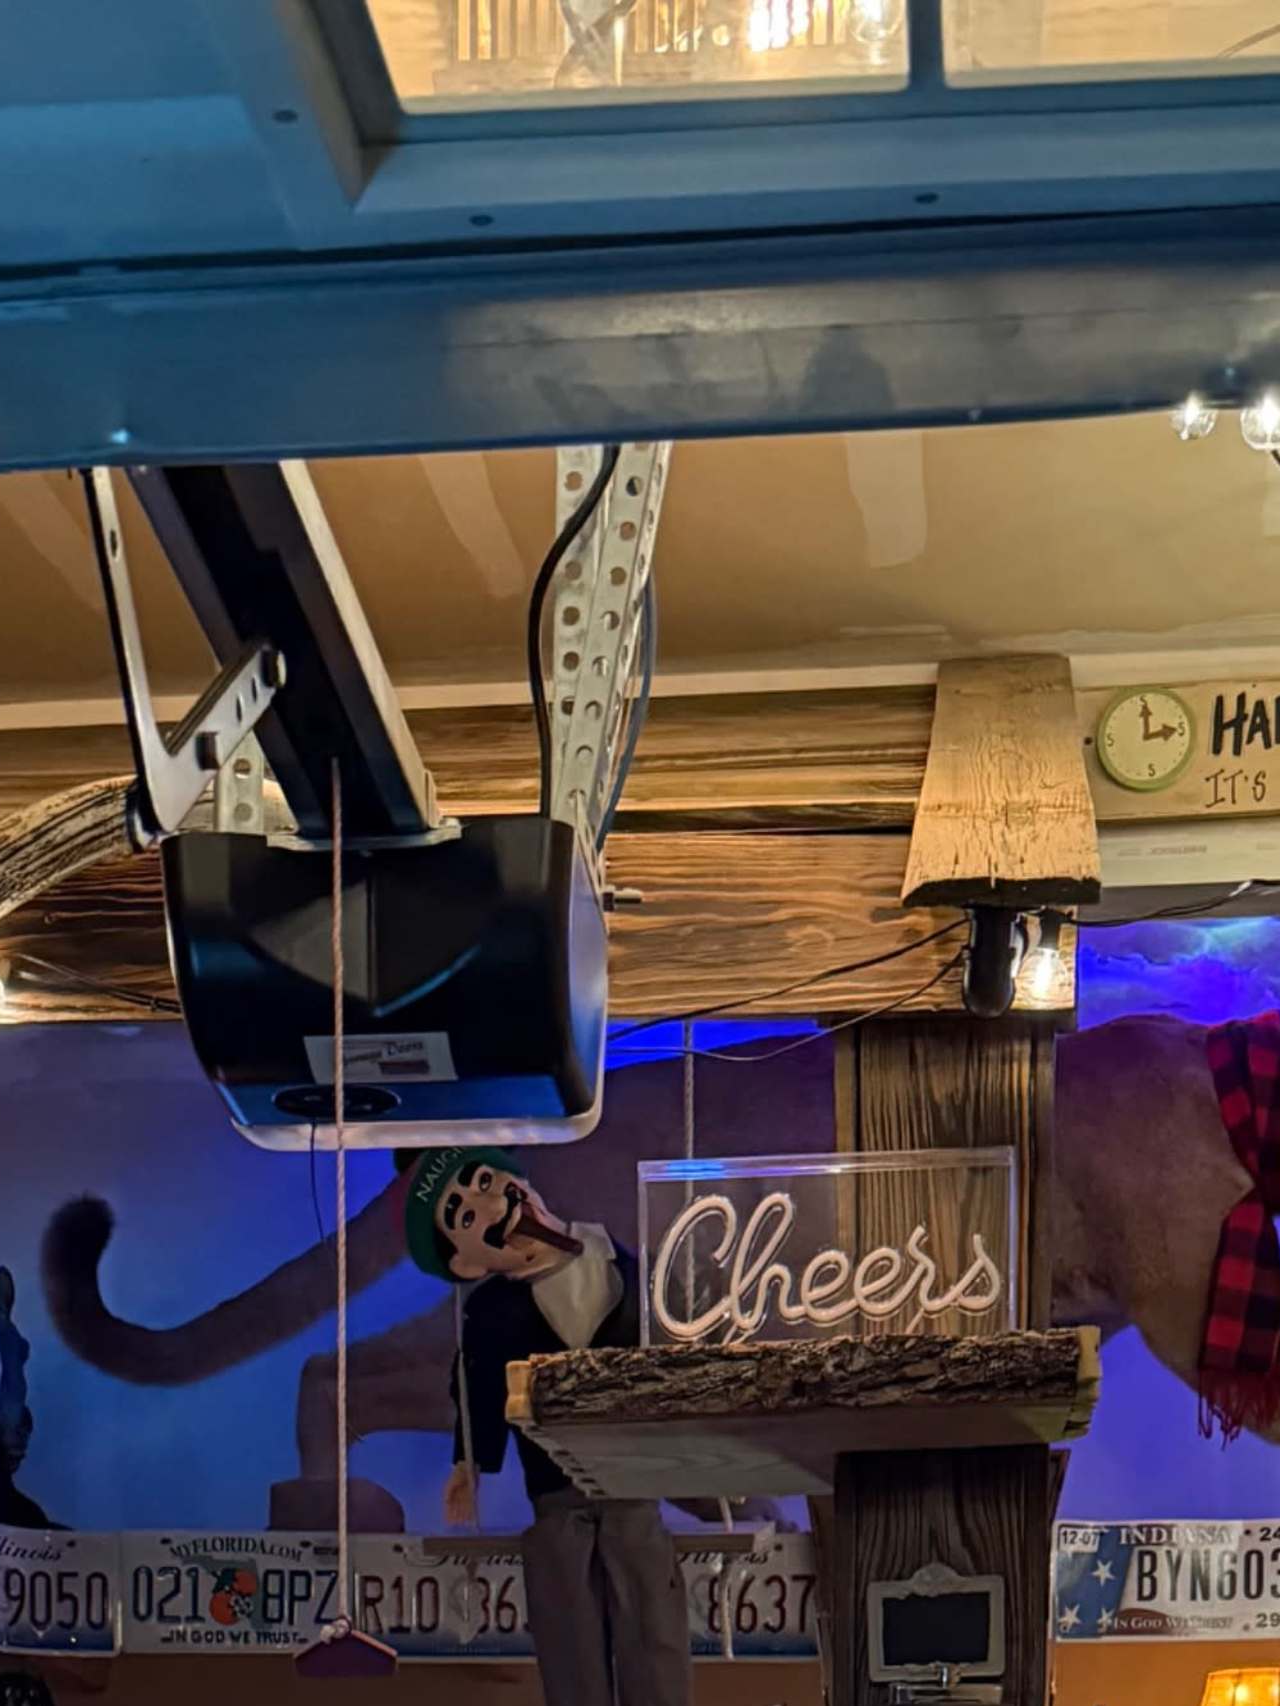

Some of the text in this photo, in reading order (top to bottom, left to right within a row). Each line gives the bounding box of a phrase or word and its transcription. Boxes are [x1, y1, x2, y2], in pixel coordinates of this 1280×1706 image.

[1205, 769, 1267, 808] IT'S
[653, 1191, 1002, 1340] Cheers
[1119, 1526, 1235, 1546] INDIANA
[4, 1568, 109, 1630] 9050
[476, 1576, 518, 1634] 36
[191, 1630, 226, 1644] GOD
[255, 1630, 299, 1645] TRUST
